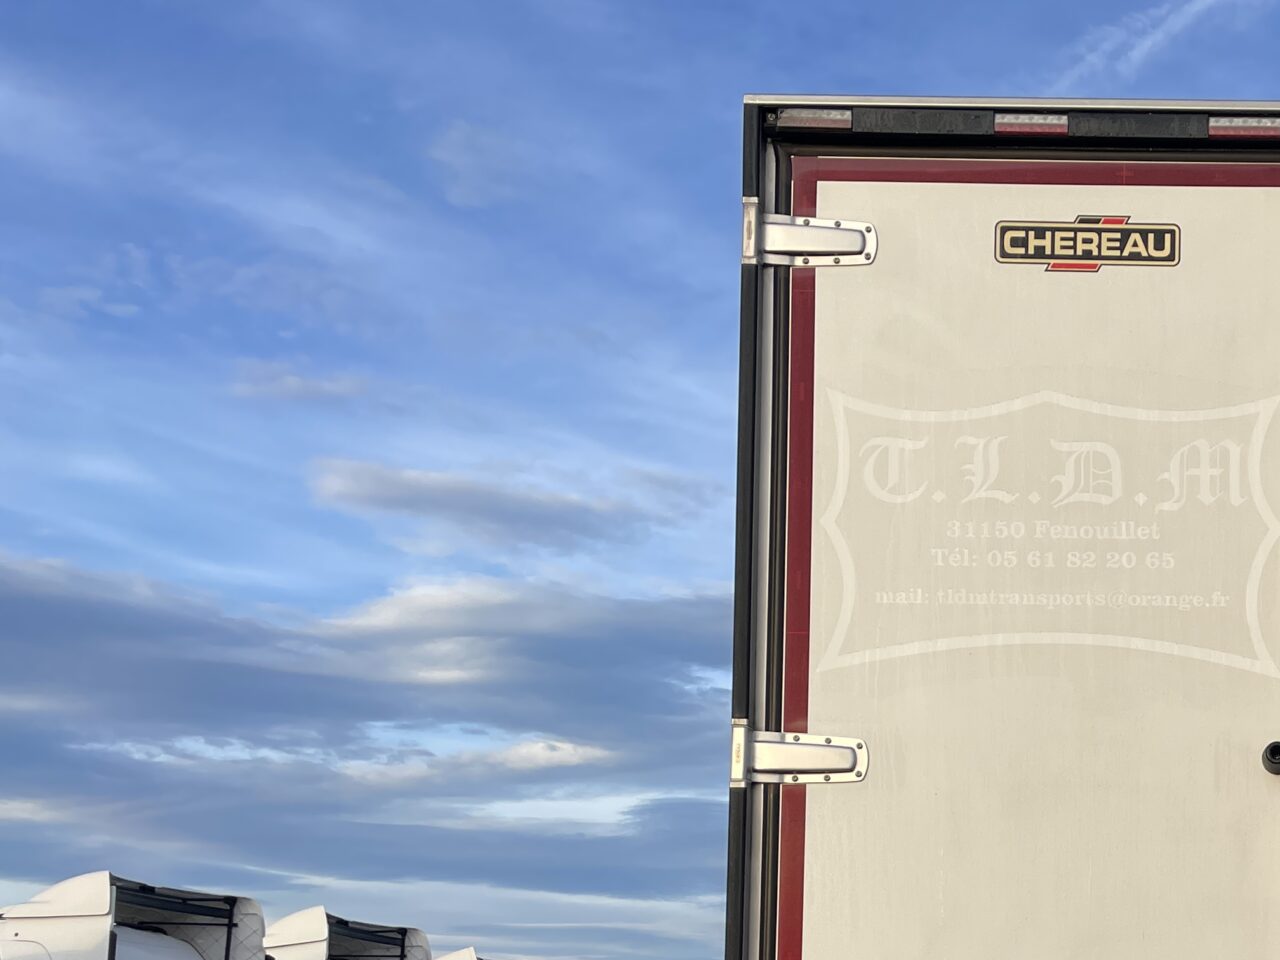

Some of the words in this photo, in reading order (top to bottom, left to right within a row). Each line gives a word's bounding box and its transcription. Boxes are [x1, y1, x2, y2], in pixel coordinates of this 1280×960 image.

[1003, 229, 1171, 258] CHEREAU
[946, 520, 1026, 539] 31150
[1033, 520, 1161, 540] Fenouillet
[930, 547, 978, 568] Tél:
[987, 549, 1019, 568] 05
[1026, 550, 1056, 568] 61
[1066, 551, 1097, 568] 82
[1105, 551, 1137, 569] 20
[1145, 552, 1176, 569] 65
[875, 588, 929, 605] mail:
